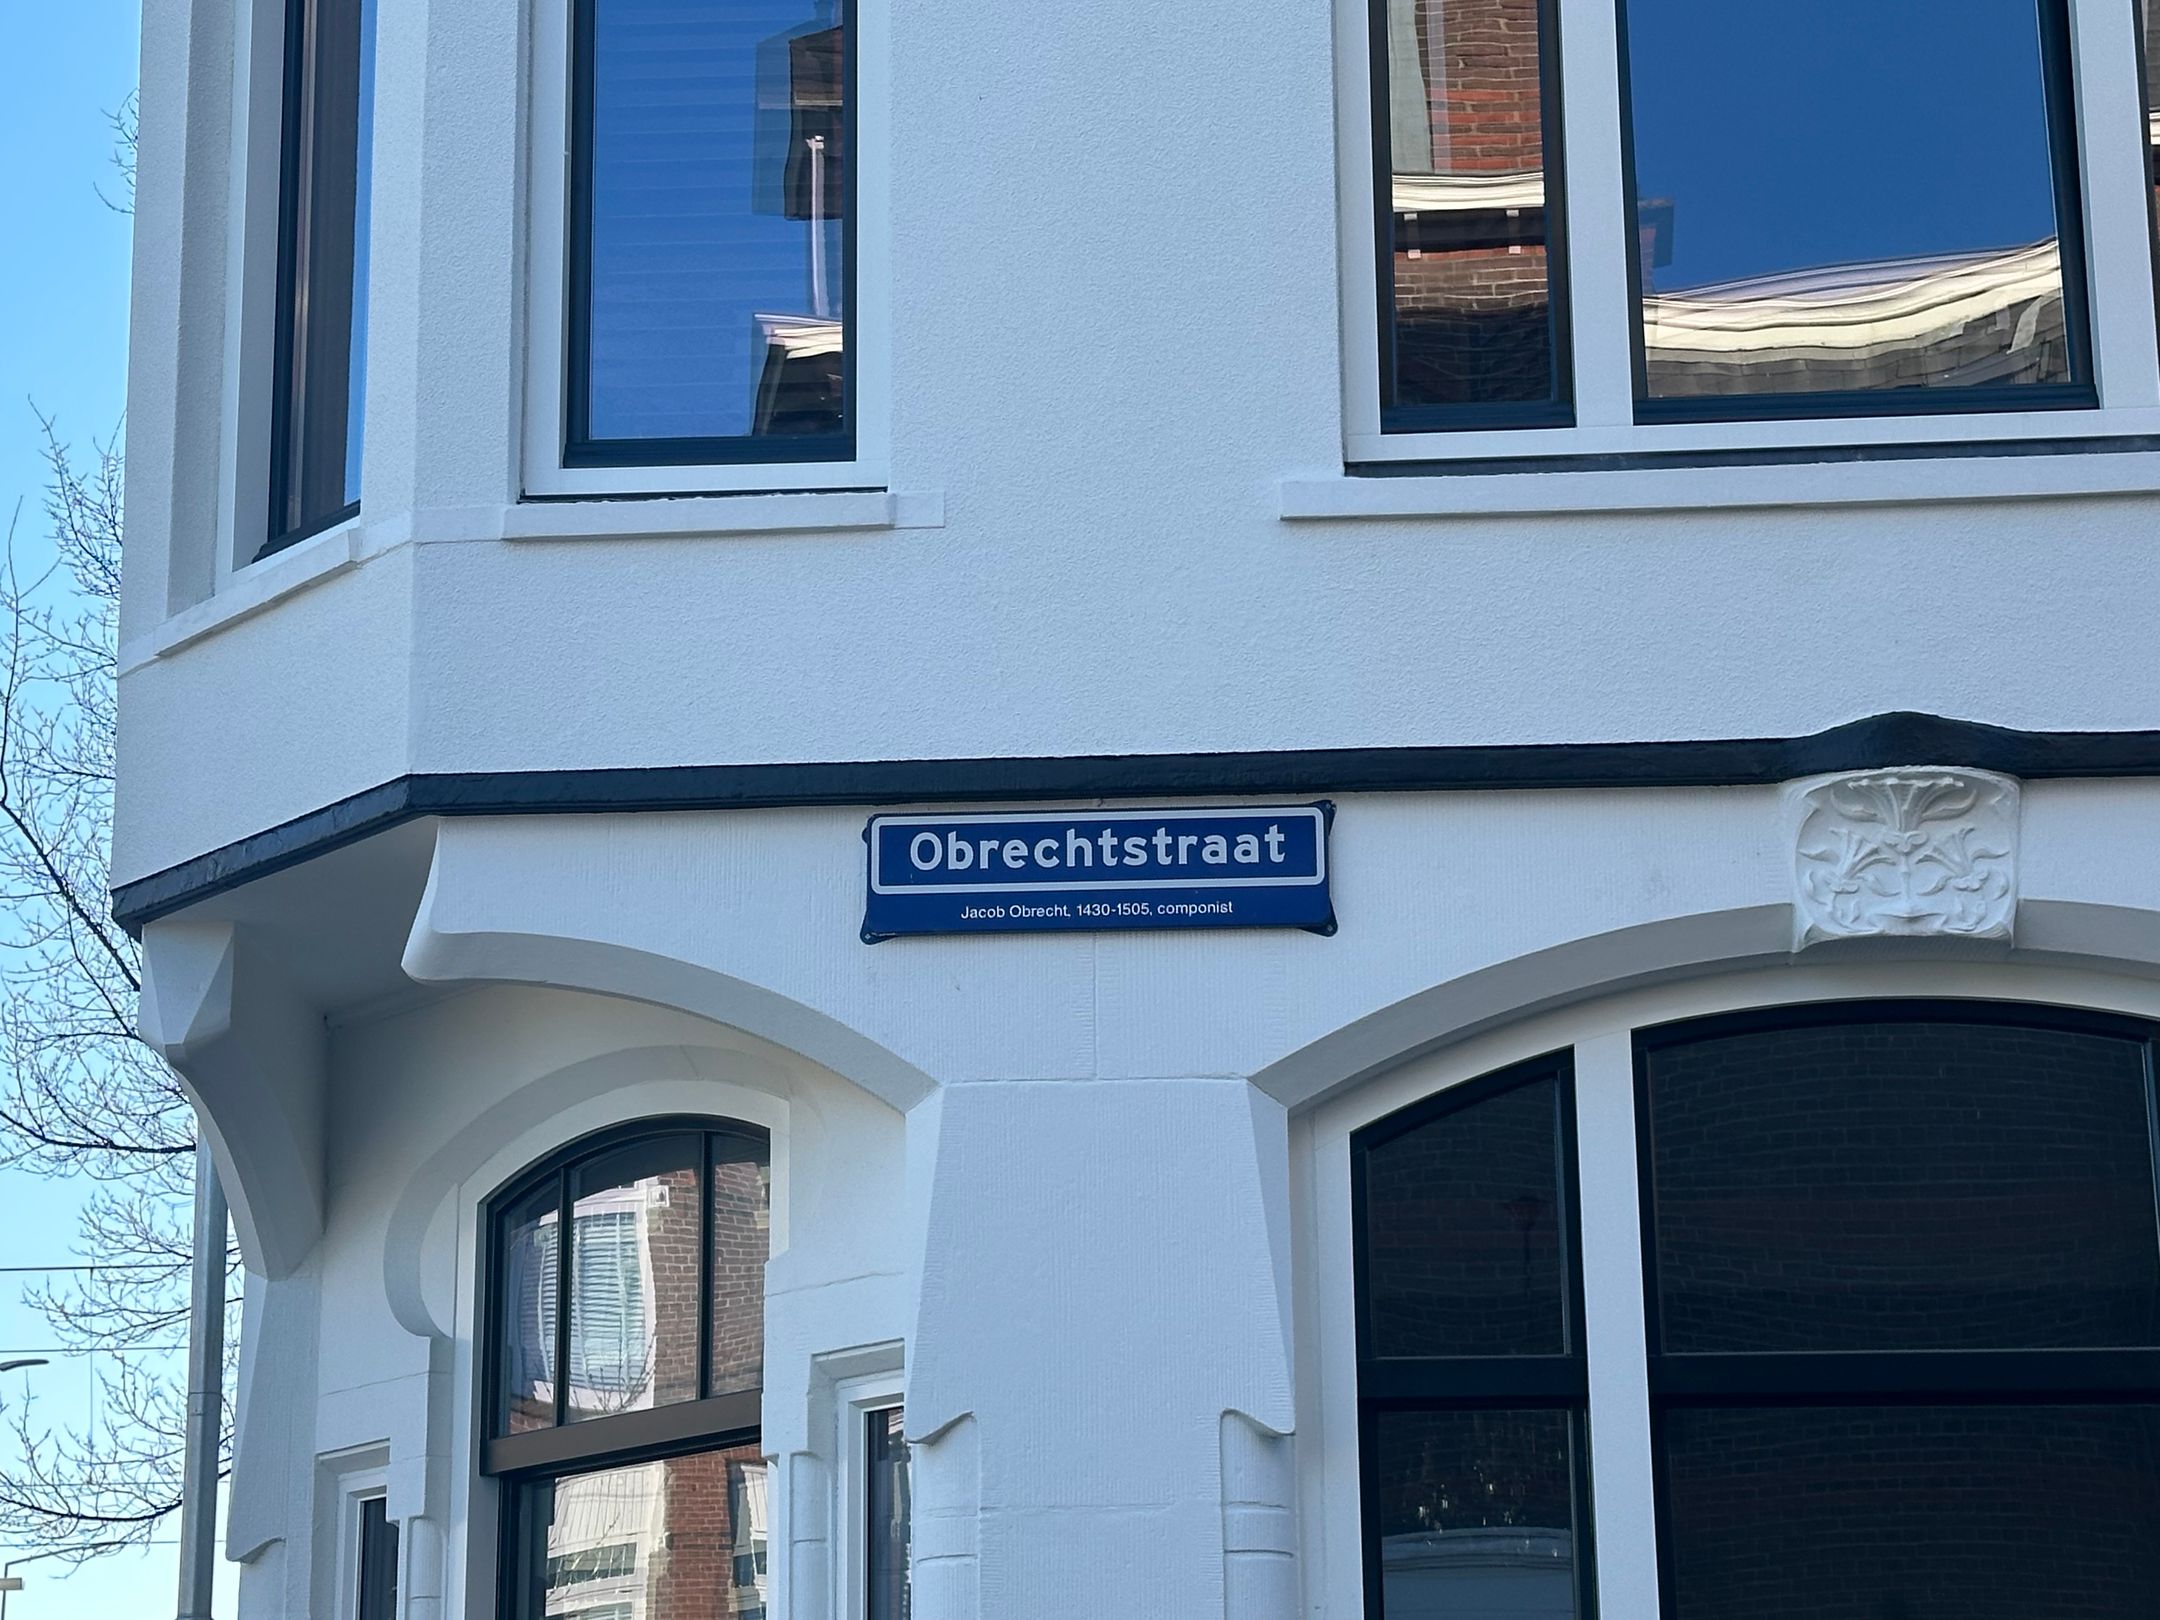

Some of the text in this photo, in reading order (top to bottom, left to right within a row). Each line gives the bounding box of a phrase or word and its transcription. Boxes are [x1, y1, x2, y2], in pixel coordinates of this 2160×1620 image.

[910, 824, 1286, 871] Obrechtstraat
[961, 901, 1233, 919] Jacob Obrecht, 1430-1505, componist
